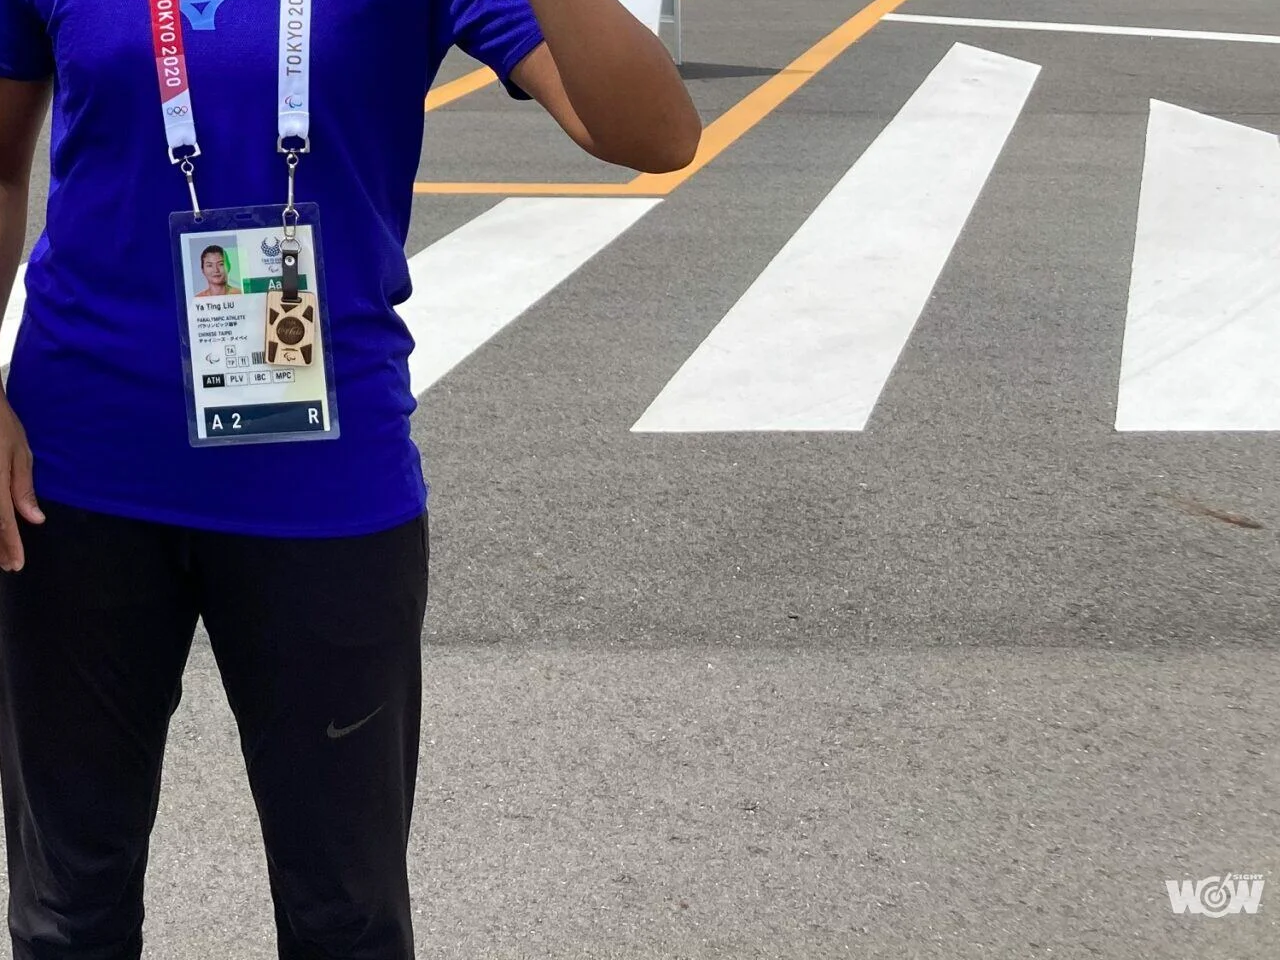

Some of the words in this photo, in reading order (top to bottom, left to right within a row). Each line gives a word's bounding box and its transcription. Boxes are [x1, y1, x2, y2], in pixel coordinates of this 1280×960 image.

[286, 21, 303, 76] TOKYO
[161, 45, 182, 87] 2020
[268, 279, 283, 290] Aa
[206, 303, 221, 311] Ting
[223, 301, 235, 309] LIU
[206, 376, 221, 385] ATH
[275, 372, 292, 380] MPC
[212, 414, 223, 430] A
[232, 413, 242, 429] 2
[308, 408, 319, 424] R
